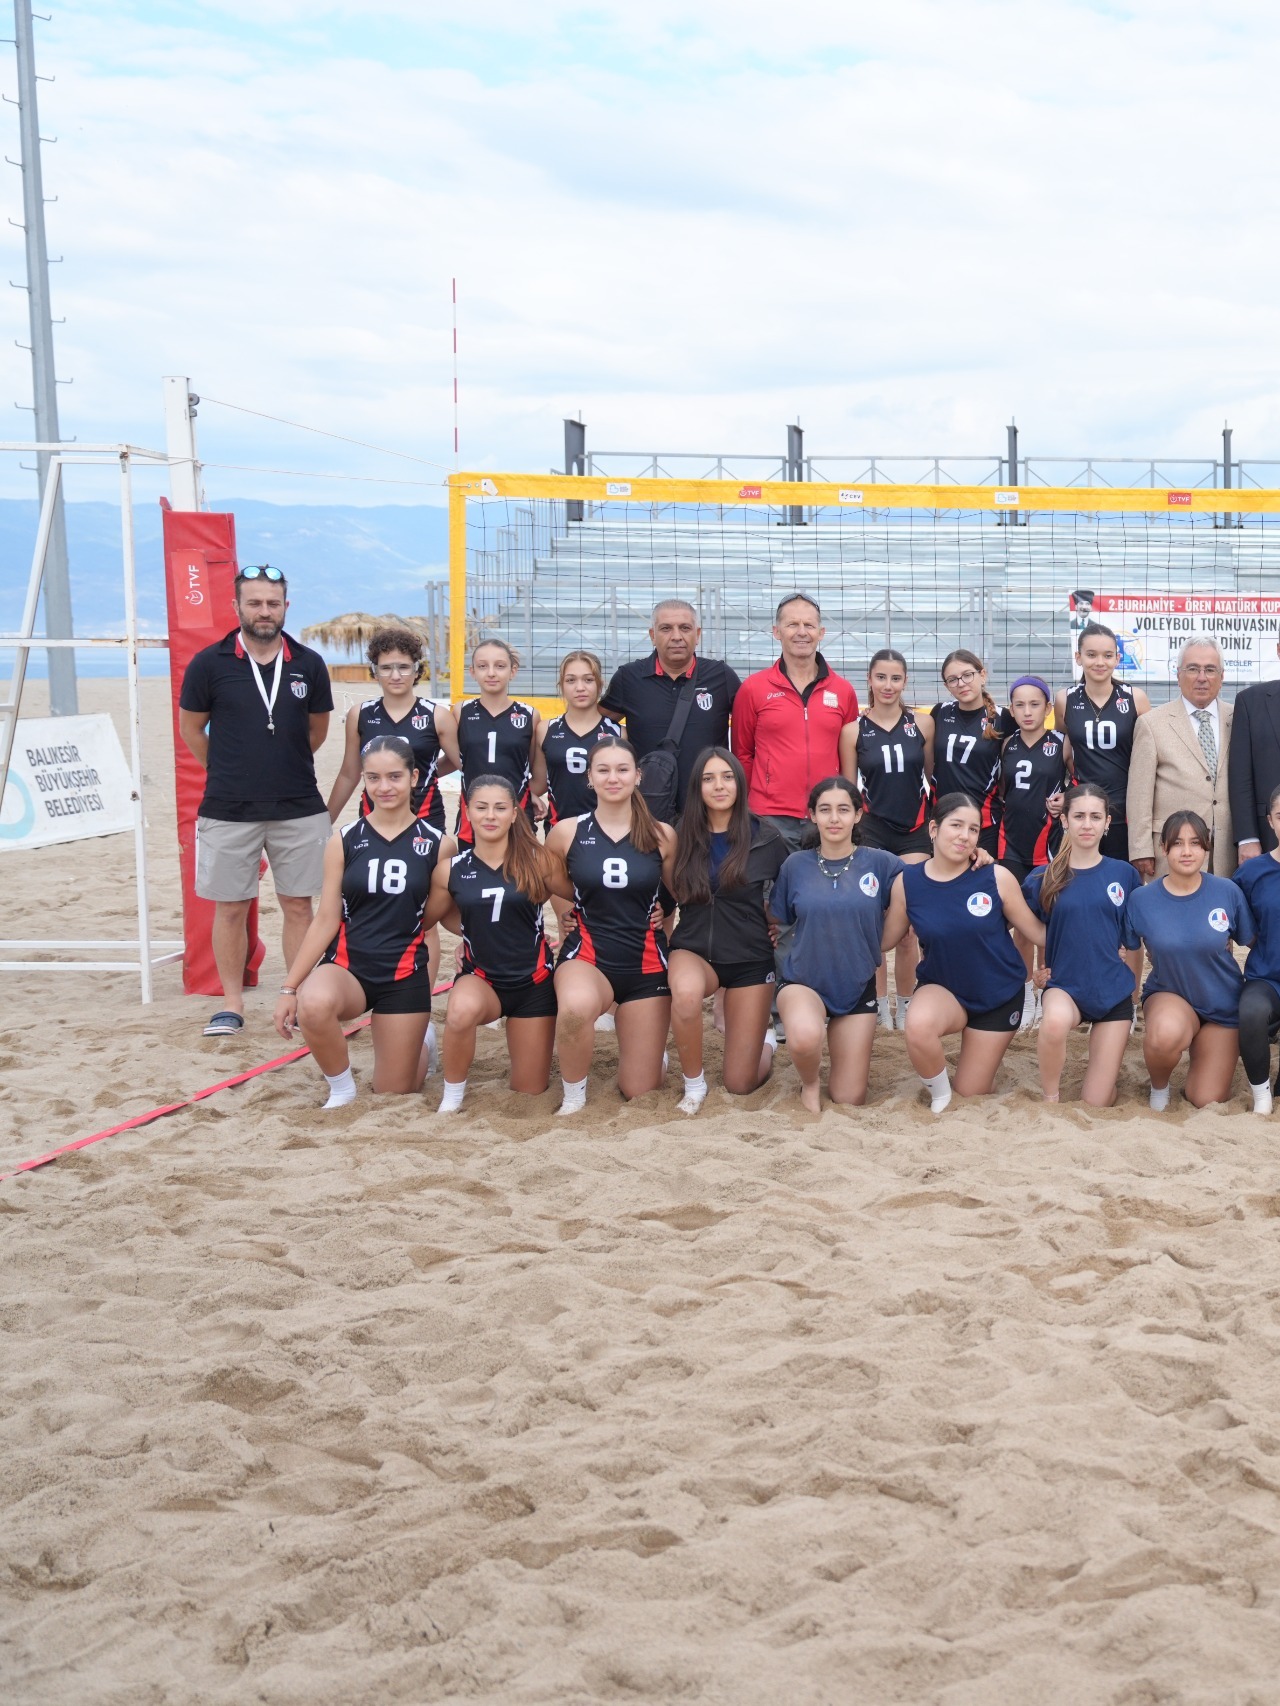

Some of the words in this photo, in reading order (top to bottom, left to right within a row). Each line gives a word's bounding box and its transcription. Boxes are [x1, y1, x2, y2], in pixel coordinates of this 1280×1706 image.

[189, 564, 200, 588] TVF
[1108, 598, 1175, 611] 2.BURHANİYE
[1185, 598, 1212, 612] ÖREN
[1214, 598, 1258, 612] ATATÜRK
[1136, 617, 1197, 631] VOLEYBOL
[1201, 617, 1280, 632] TURNUVASIN
[1220, 633, 1252, 650] DİNİZ
[487, 731, 497, 763] 1
[946, 733, 977, 764] 17
[1084, 720, 1116, 750] 10
[26, 741, 82, 767] BALIKESİR
[565, 747, 588, 774] 6
[881, 743, 905, 774] 11
[35, 764, 102, 793] BÜYÜKŞEHİR
[1015, 759, 1033, 790] 2
[44, 789, 105, 818] BELEDİYESİ
[367, 858, 408, 895] 18
[602, 857, 629, 888] 8
[481, 887, 506, 922] 7
